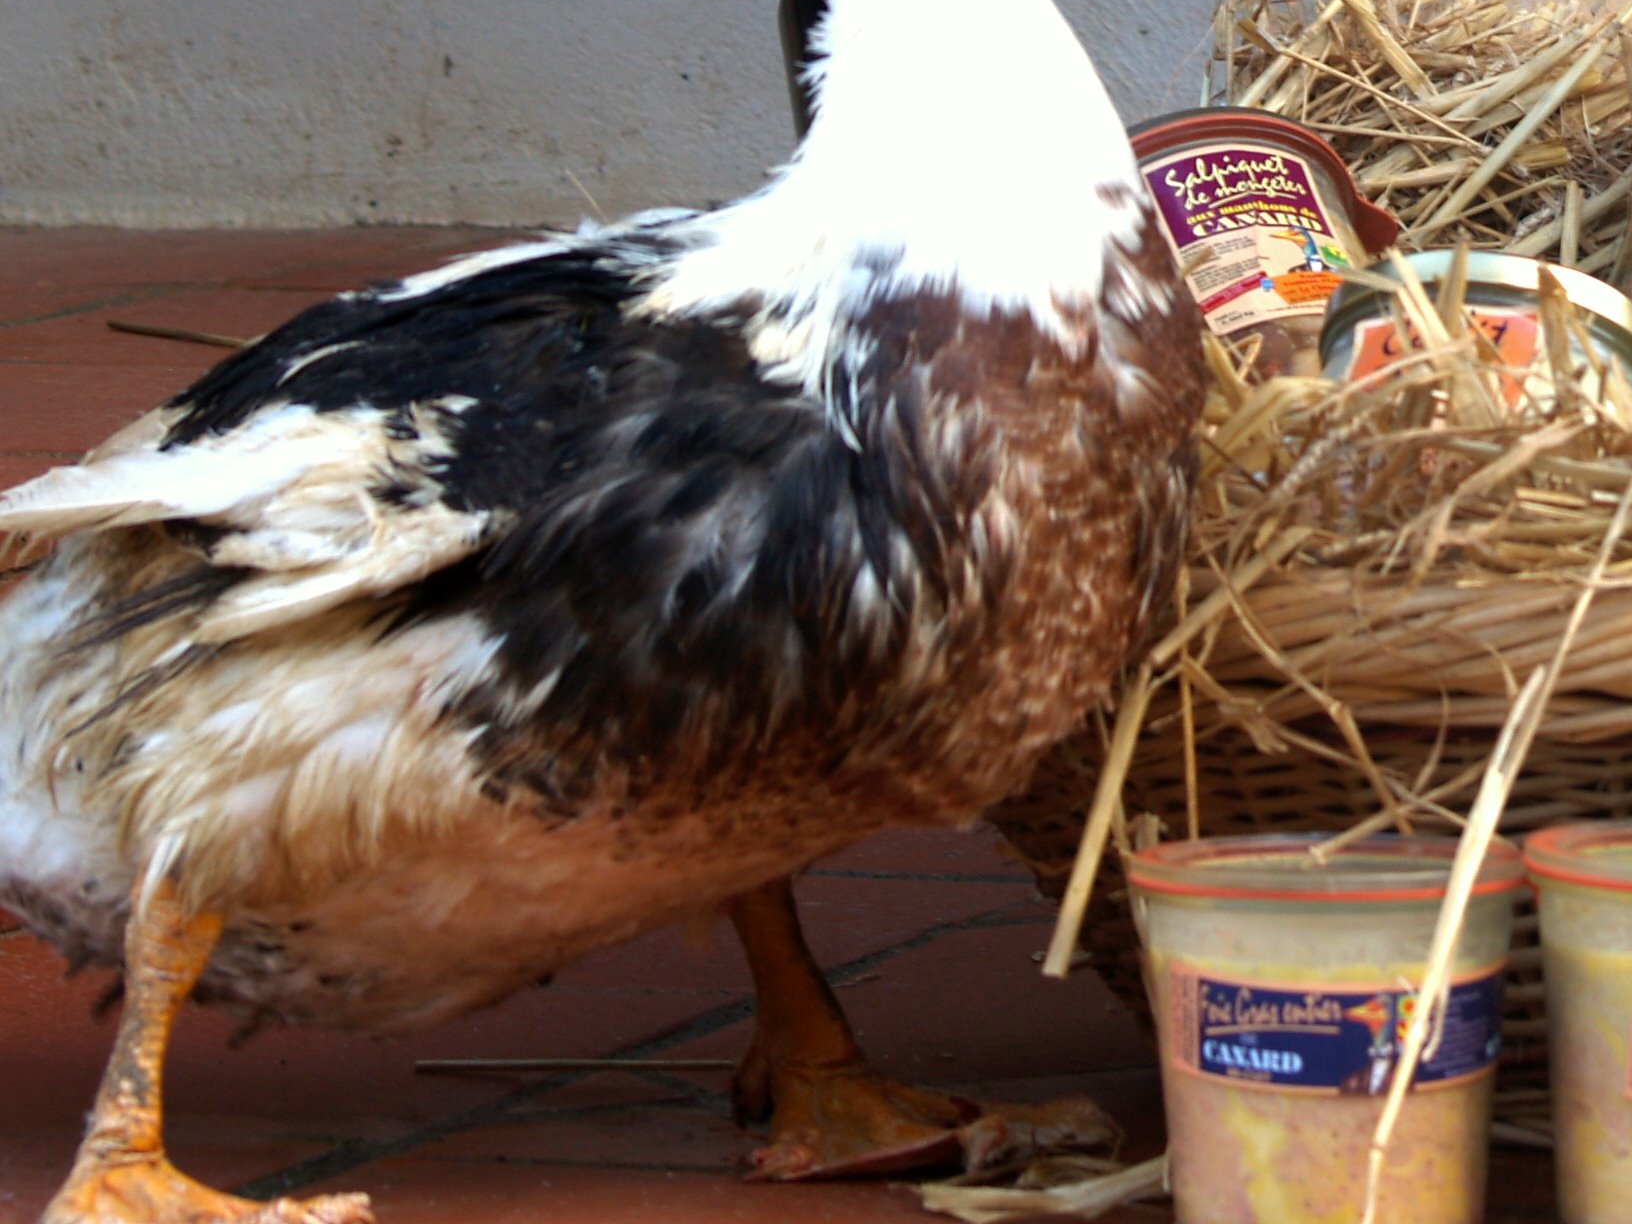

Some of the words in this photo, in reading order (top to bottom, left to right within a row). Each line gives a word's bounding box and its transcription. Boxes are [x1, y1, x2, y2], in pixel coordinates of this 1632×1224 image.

[1165, 155, 1289, 197] Salpiquet
[1185, 186, 1211, 211] de
[1192, 211, 1324, 237] CANARD
[1202, 1037, 1304, 1076] CANARD
